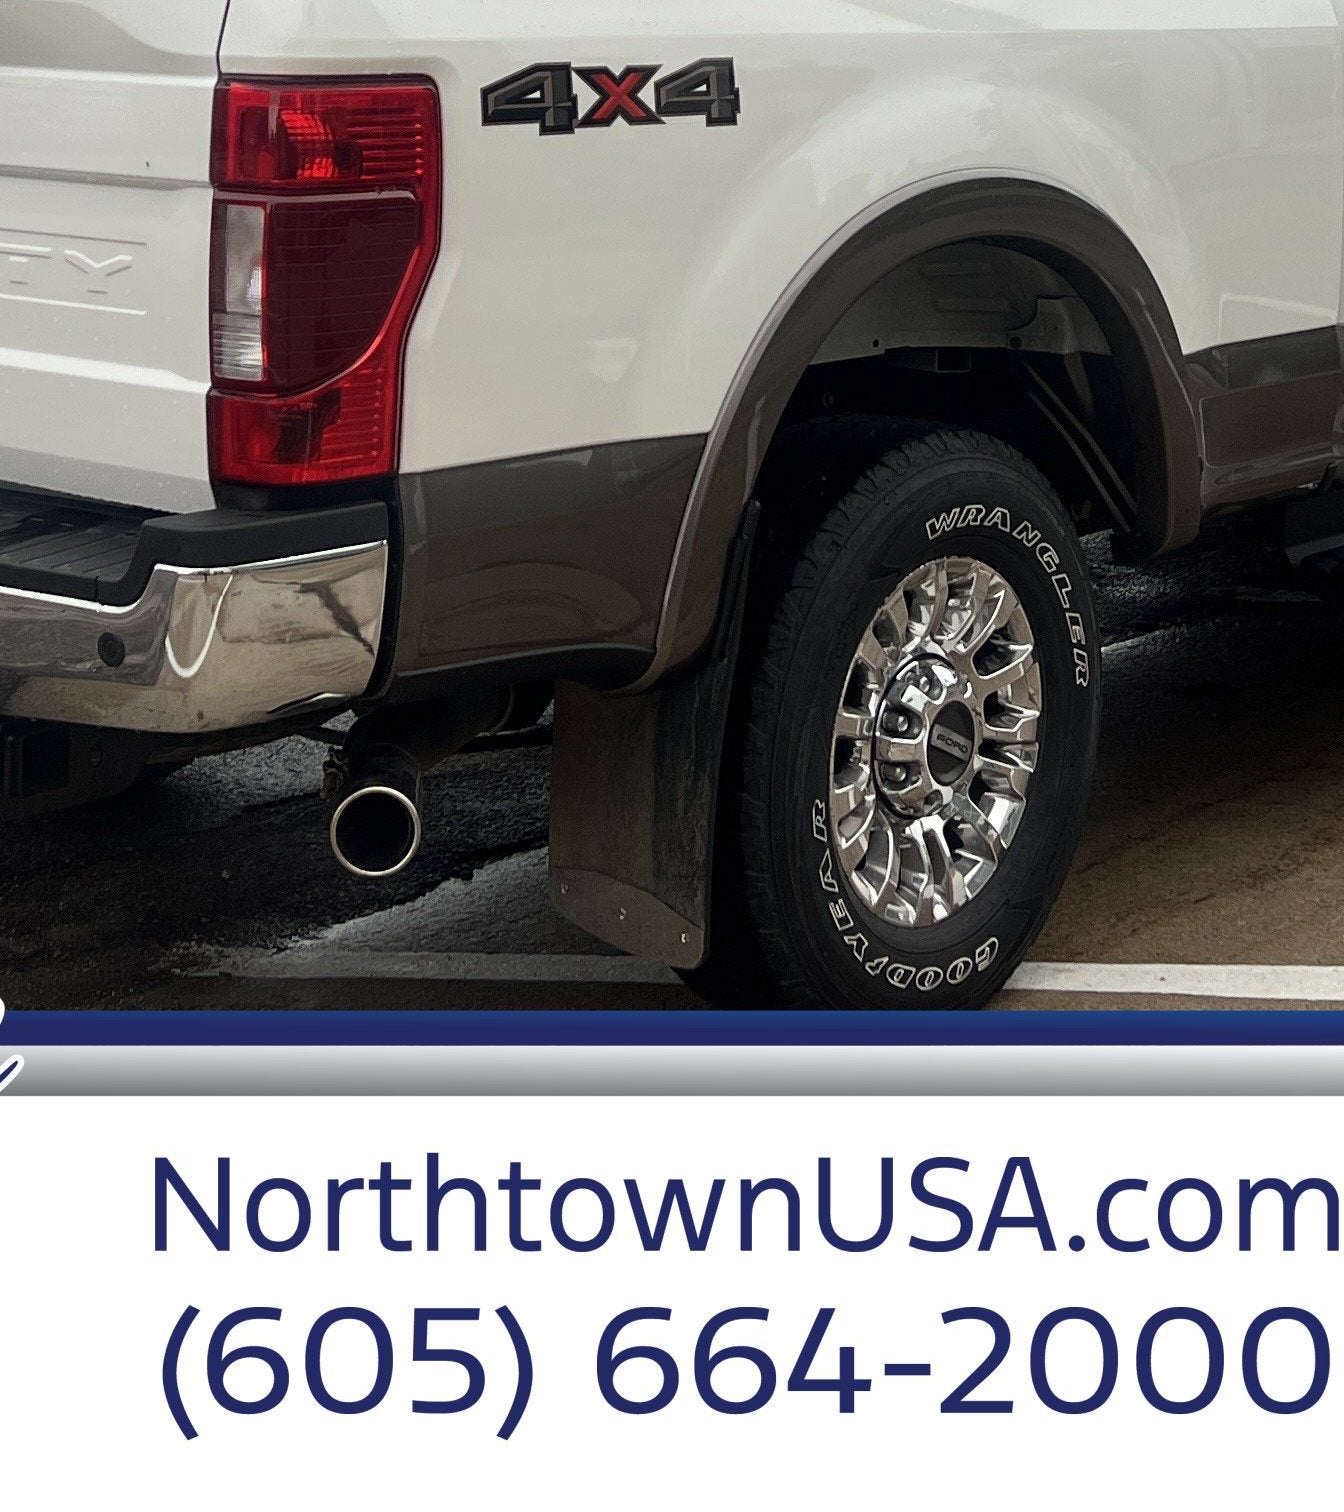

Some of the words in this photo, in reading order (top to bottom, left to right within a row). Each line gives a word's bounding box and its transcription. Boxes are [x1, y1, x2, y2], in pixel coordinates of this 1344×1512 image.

[926, 505, 1090, 688] WRANGLER
[936, 733, 968, 754] FORD
[812, 799, 999, 991] GOODYEAR
